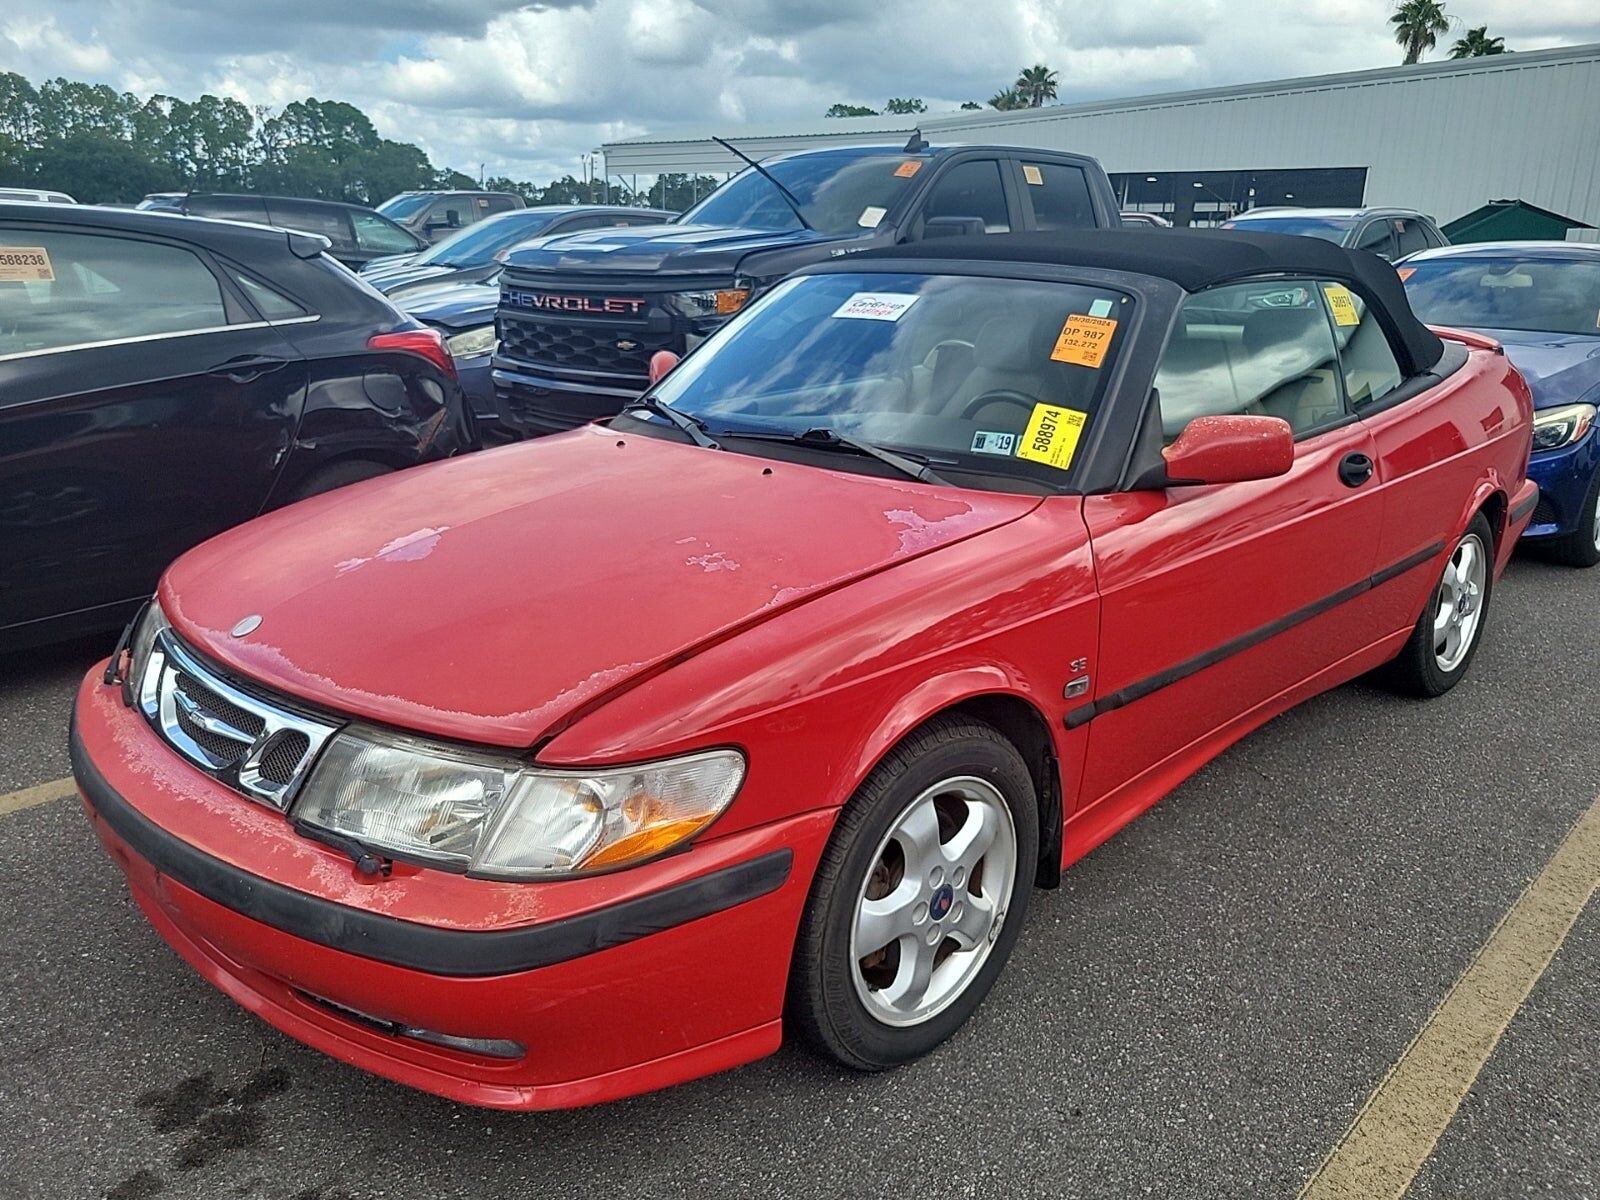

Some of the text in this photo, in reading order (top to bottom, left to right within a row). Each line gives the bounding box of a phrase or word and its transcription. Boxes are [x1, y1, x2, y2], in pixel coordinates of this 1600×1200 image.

[0, 254, 45, 266] 588238
[501, 291, 645, 313] CHEVROLET
[1063, 327, 1080, 336] DP
[1083, 330, 1105, 340] 987
[1032, 410, 1061, 452] 588974
[1070, 657, 1088, 672] SE
